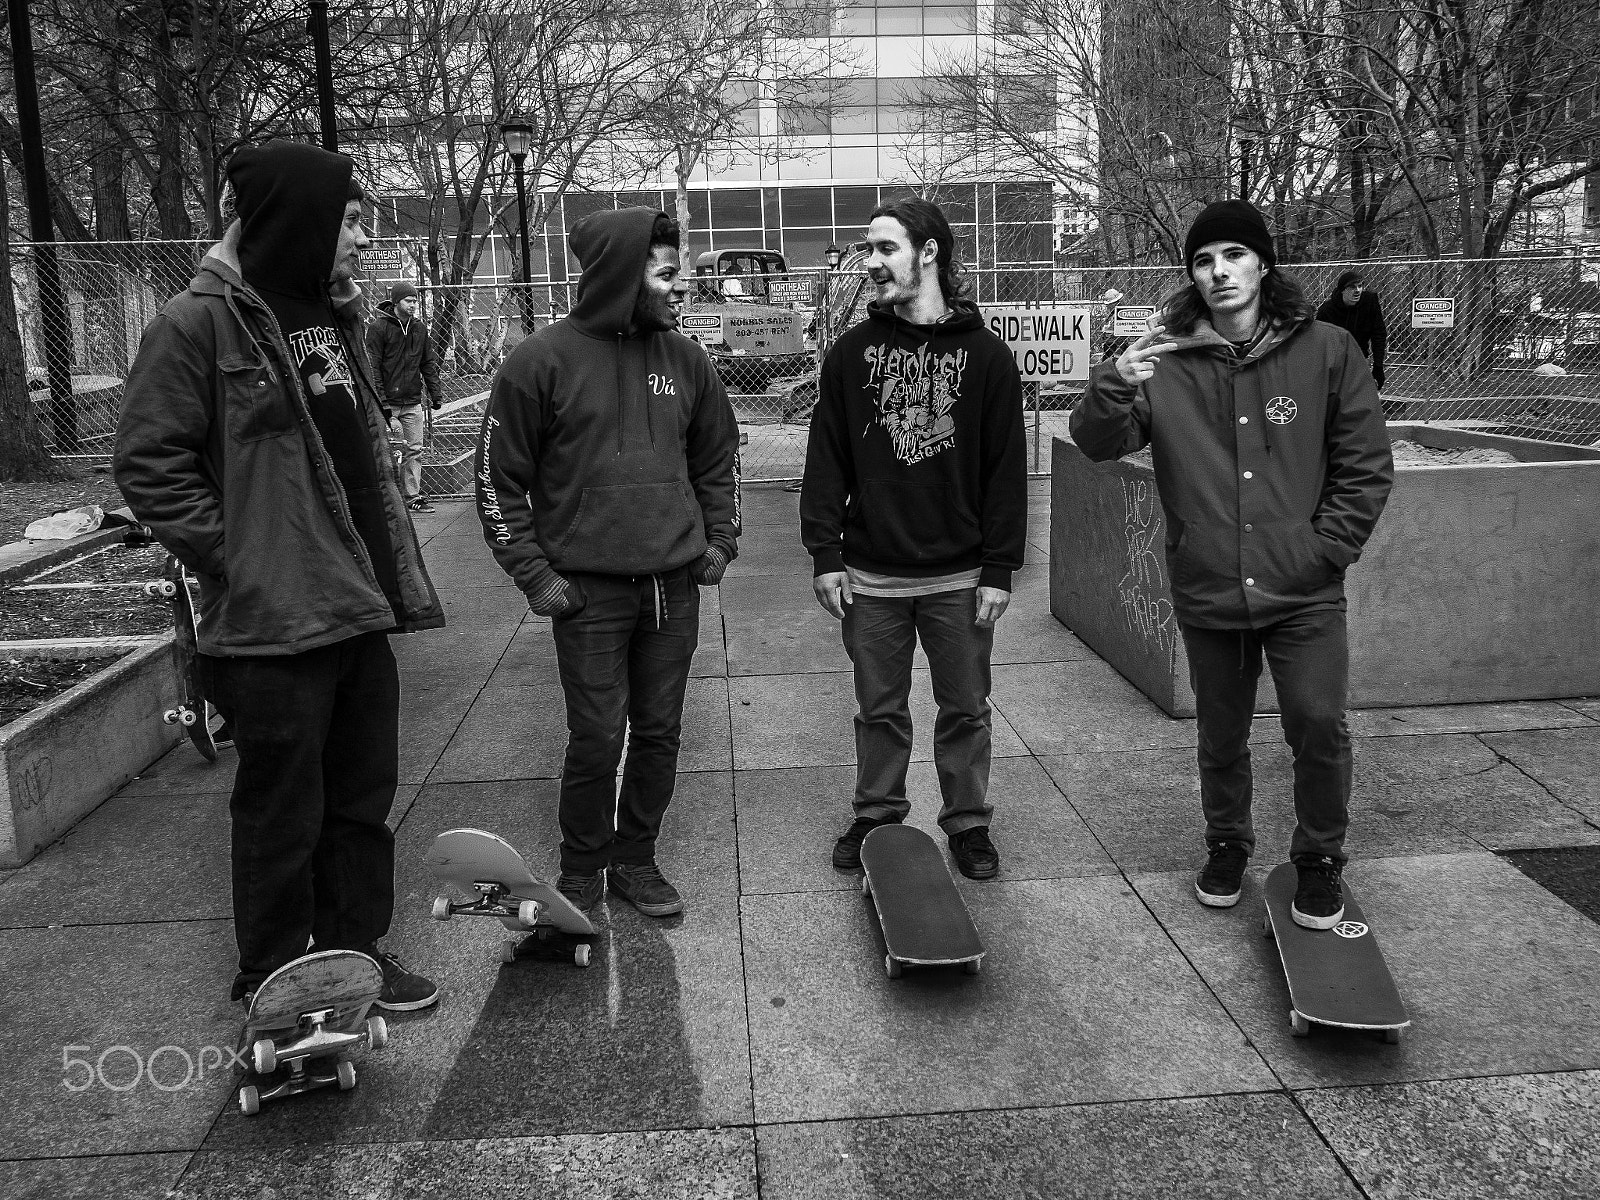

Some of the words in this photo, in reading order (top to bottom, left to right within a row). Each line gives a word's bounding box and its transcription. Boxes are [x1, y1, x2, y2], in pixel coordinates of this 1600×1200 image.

[360, 250, 401, 260] NORTHEAST
[770, 282, 810, 292] NORTHEAST
[687, 318, 716, 326] DANGER
[766, 317, 793, 325] SALES
[990, 315, 1085, 341] SIDEWALK
[289, 325, 340, 369] THRA
[1013, 349, 1074, 376] OSED
